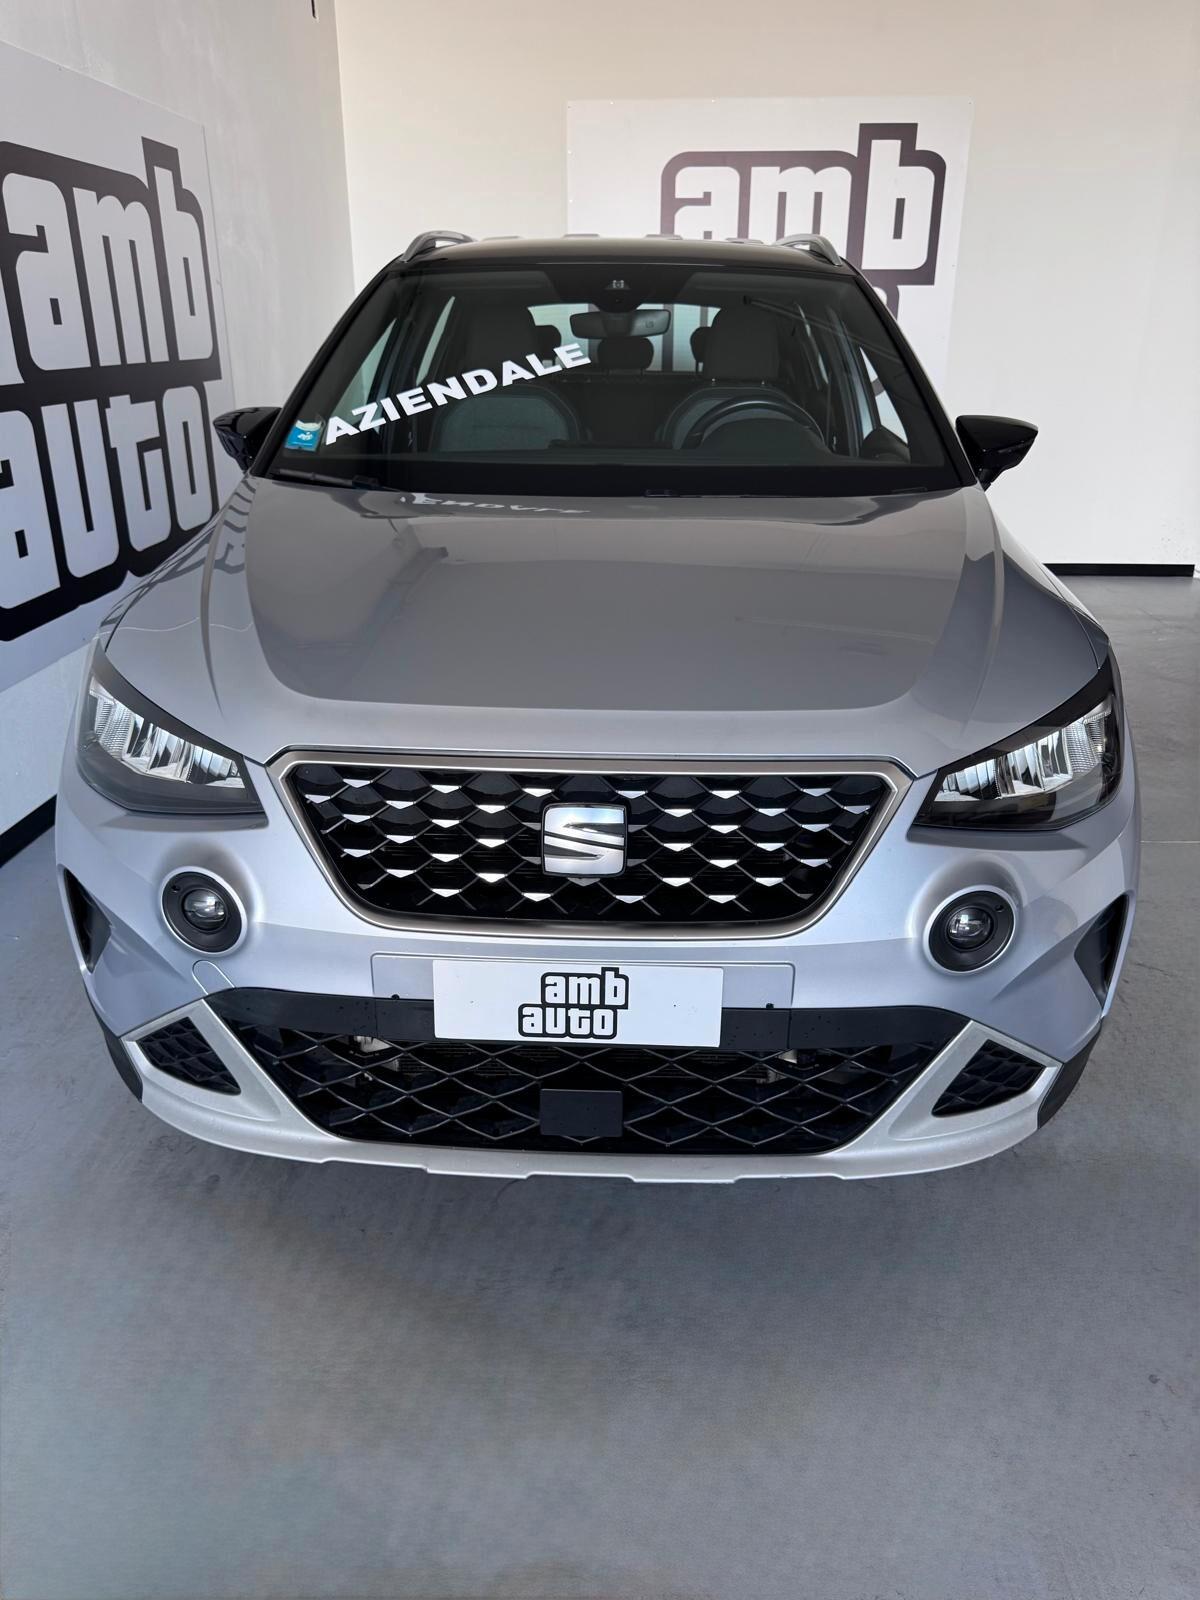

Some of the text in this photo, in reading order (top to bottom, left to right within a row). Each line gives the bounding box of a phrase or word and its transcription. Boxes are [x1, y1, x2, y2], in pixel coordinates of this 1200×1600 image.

[670, 136, 937, 272] amb
[1, 162, 214, 371] amb
[325, 342, 592, 446] AZIENDALE
[520, 1005, 616, 1038] auto
[543, 969, 627, 1007] amb
